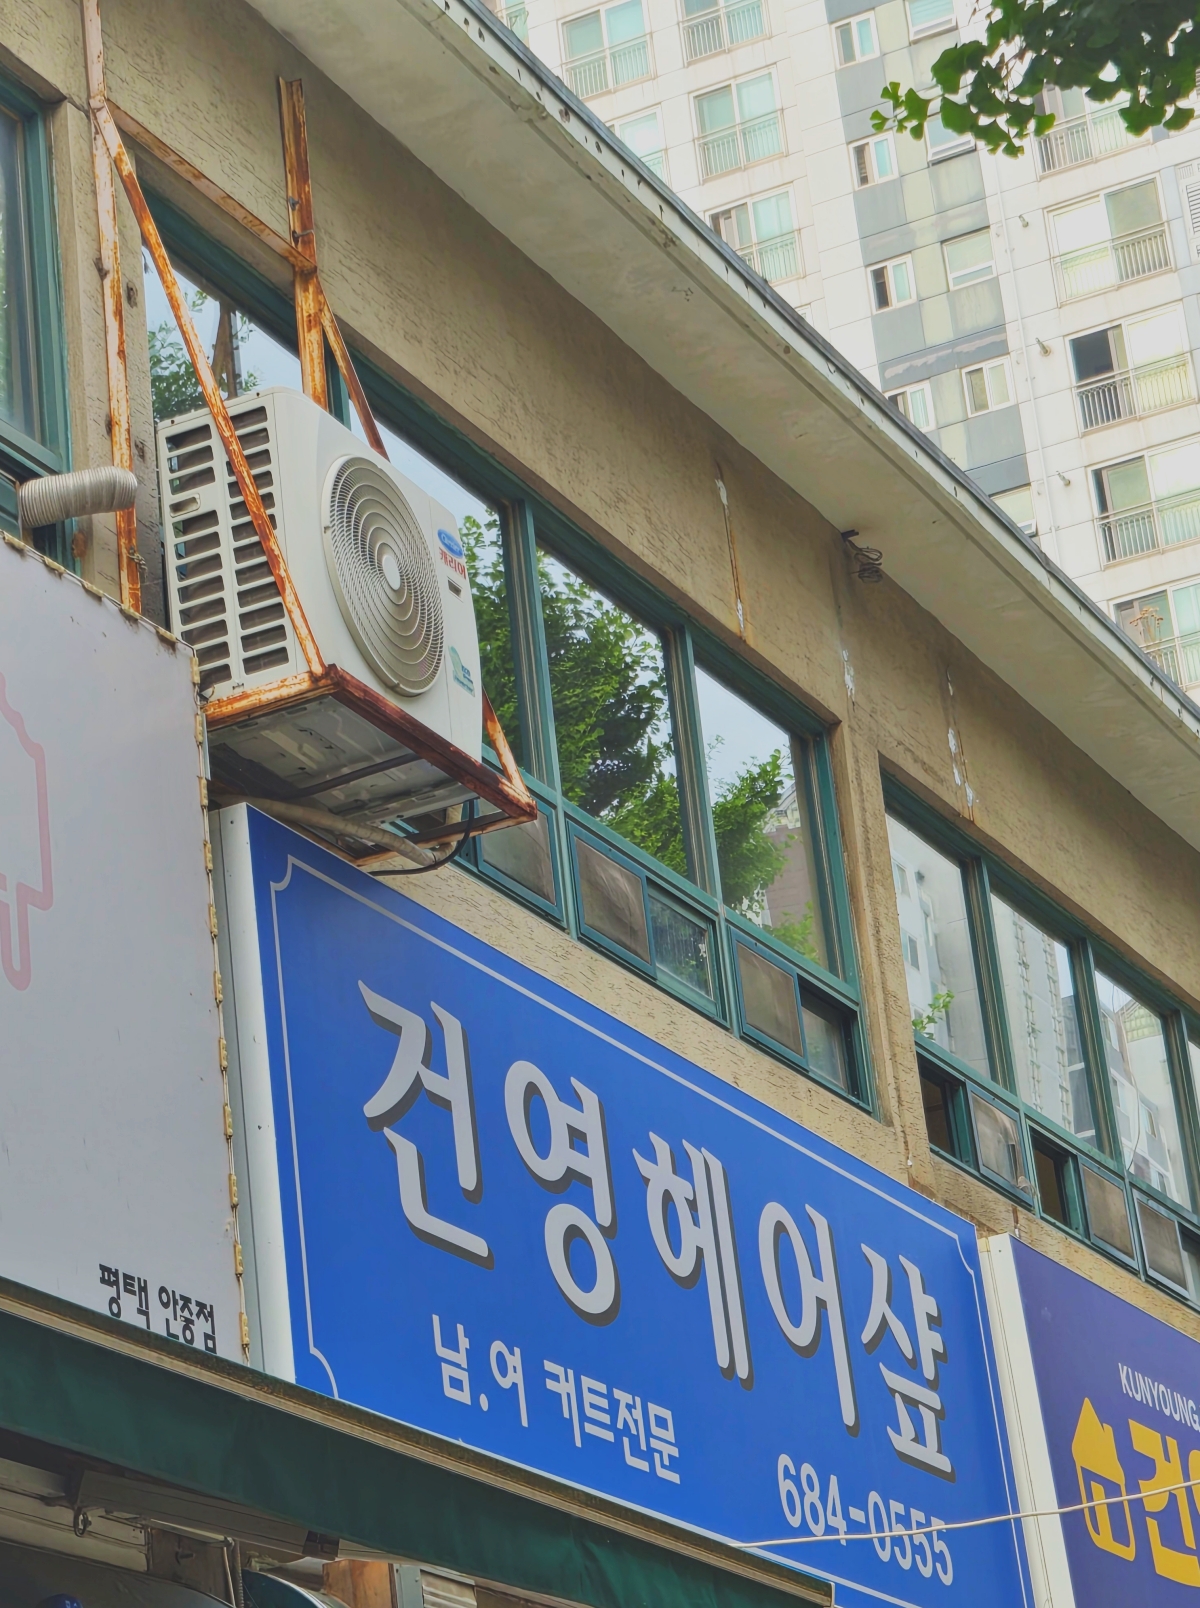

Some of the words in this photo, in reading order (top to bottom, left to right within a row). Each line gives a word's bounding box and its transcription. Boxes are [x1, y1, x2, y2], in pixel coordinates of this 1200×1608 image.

[439, 548, 466, 580] 캐리어
[98, 1263, 151, 1330] 평택
[158, 1286, 218, 1355] 안중점
[543, 1359, 680, 1484] 커트전문
[777, 1453, 954, 1587] 684-0555
[1127, 1418, 1200, 1588] 건
